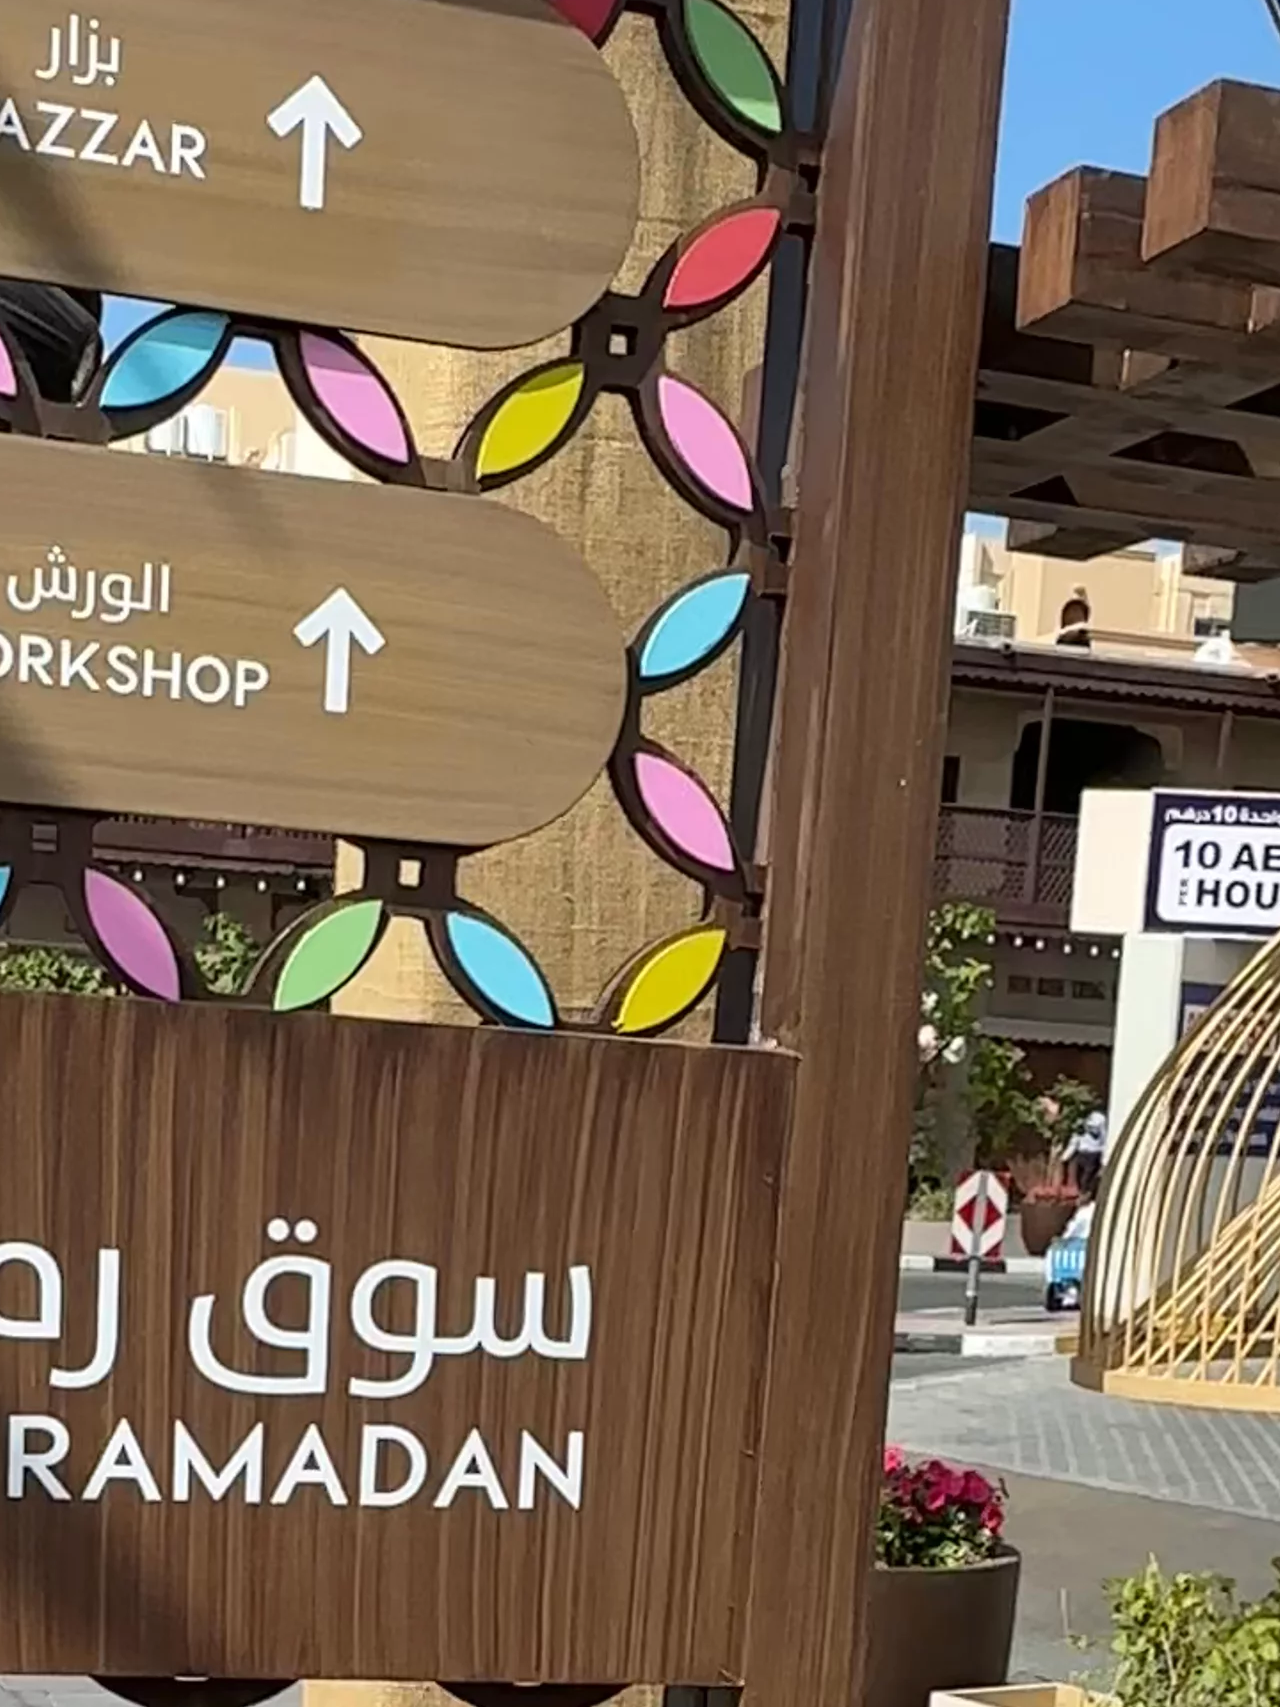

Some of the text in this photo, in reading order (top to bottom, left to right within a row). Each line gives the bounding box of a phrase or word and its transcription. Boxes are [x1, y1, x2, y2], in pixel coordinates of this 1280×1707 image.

[35, 14, 120, 86] بزار
[7, 545, 170, 623] الورش
[1212, 805, 1237, 823] 10
[1175, 840, 1222, 870] 10
[189, 1218, 592, 1398] سوق
[8, 1415, 584, 1510] RAMADAN
